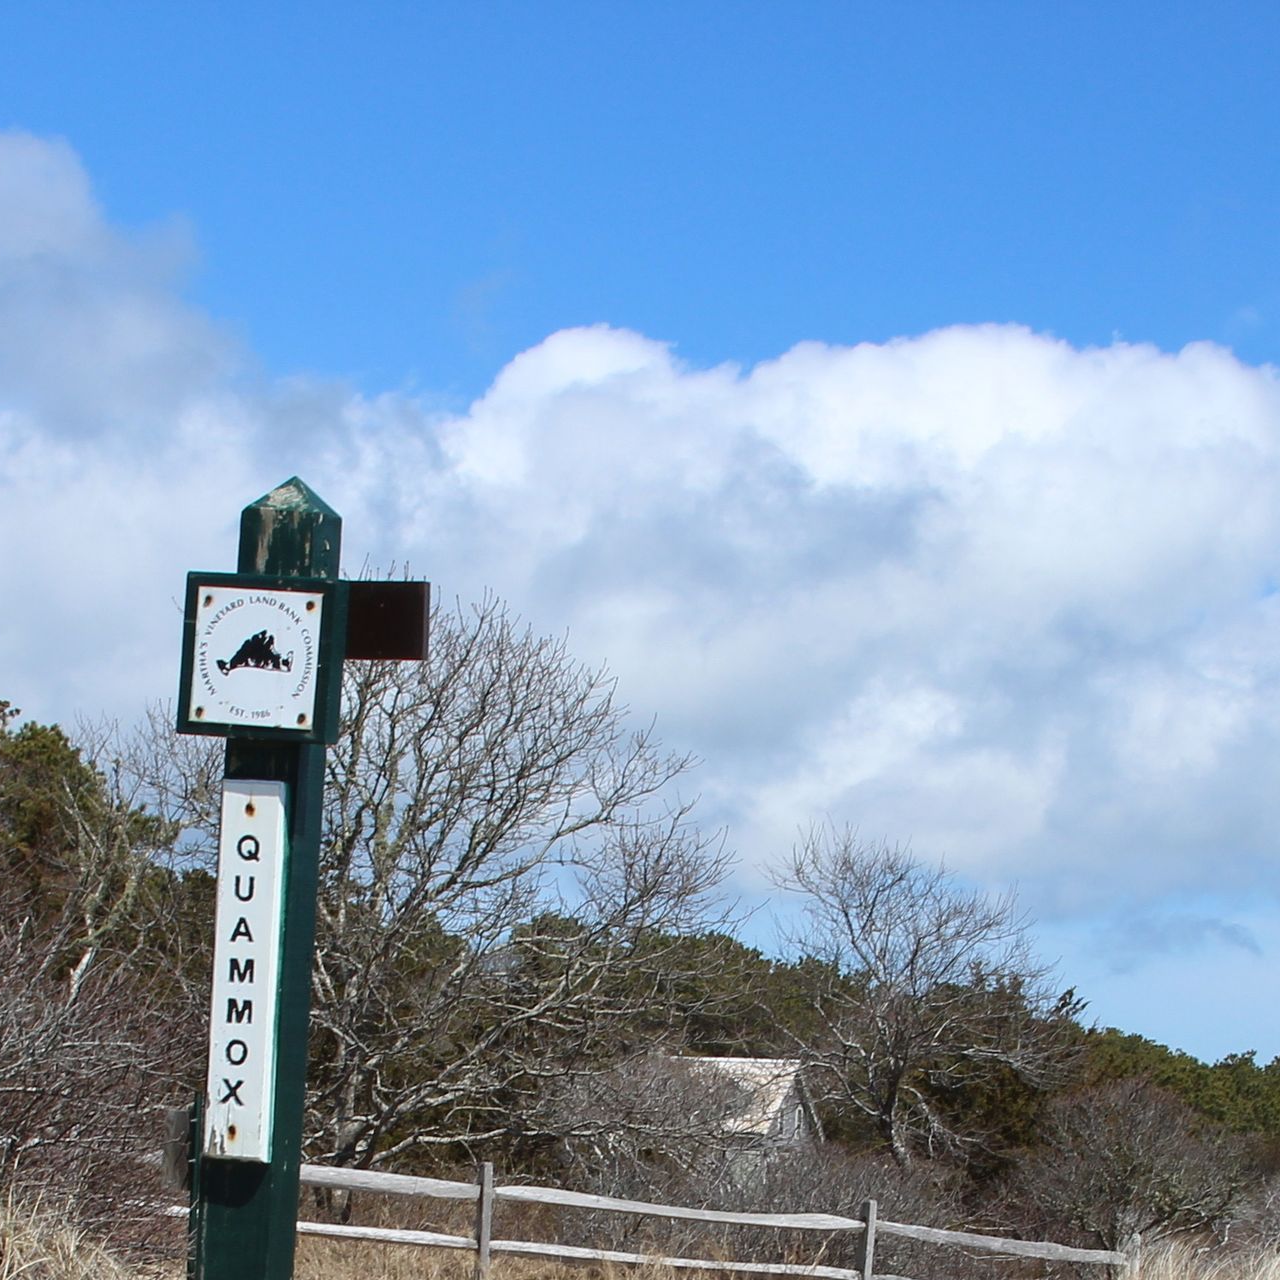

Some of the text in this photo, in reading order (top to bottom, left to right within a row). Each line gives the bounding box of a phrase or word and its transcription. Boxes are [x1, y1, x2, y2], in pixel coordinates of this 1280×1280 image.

[199, 595, 313, 700] MARTHA'S VINEYARD LAND BANK COMMISSION
[229, 706, 248, 719] EST.
[221, 834, 260, 1106] QUAMMOX
